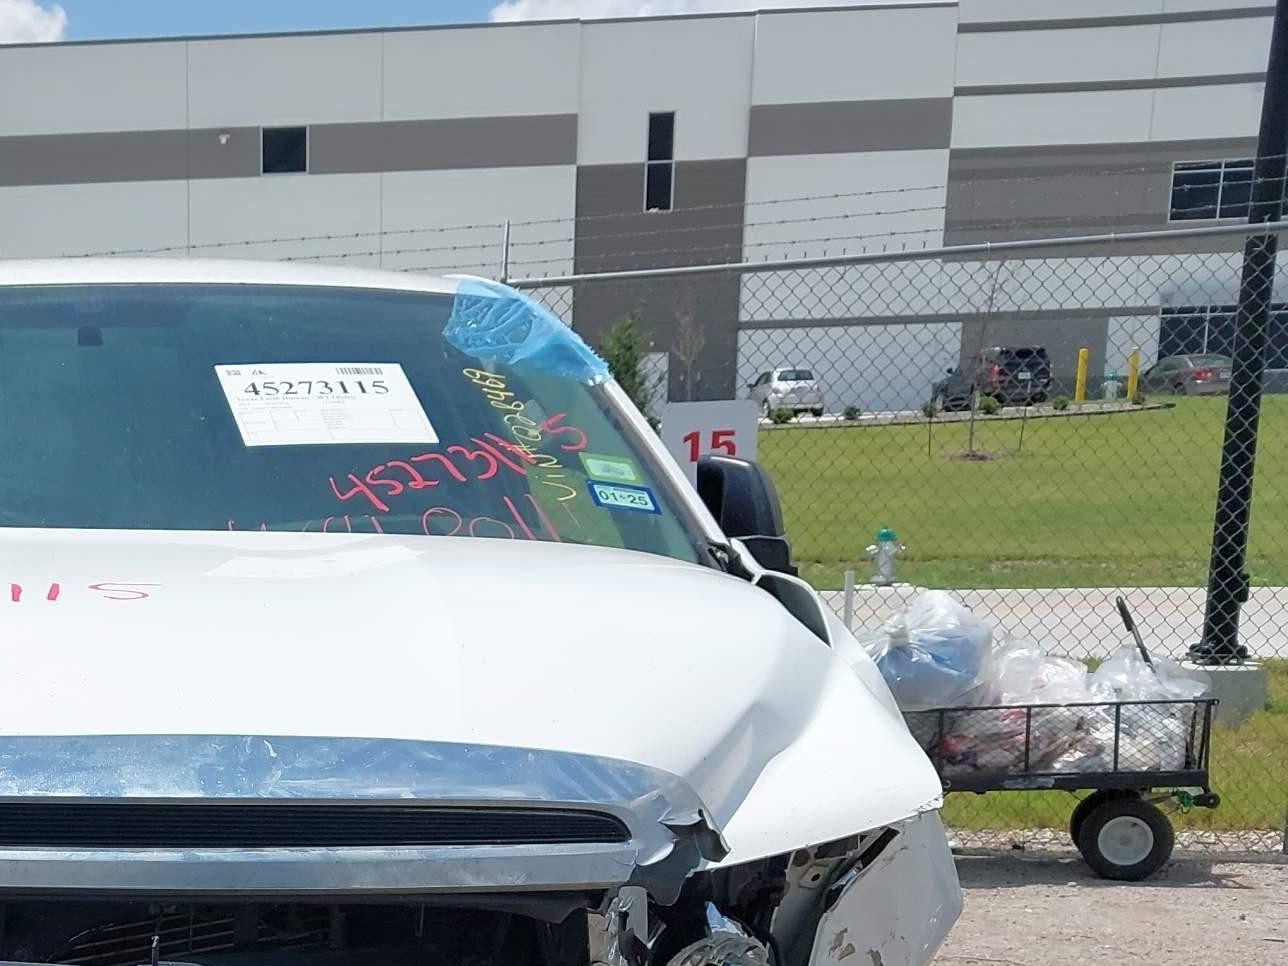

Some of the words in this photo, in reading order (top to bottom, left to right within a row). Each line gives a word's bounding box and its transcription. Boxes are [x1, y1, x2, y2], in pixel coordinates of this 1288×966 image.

[243, 380, 390, 396] 45273115
[329, 413, 588, 513] 45273115
[682, 429, 738, 463] 15
